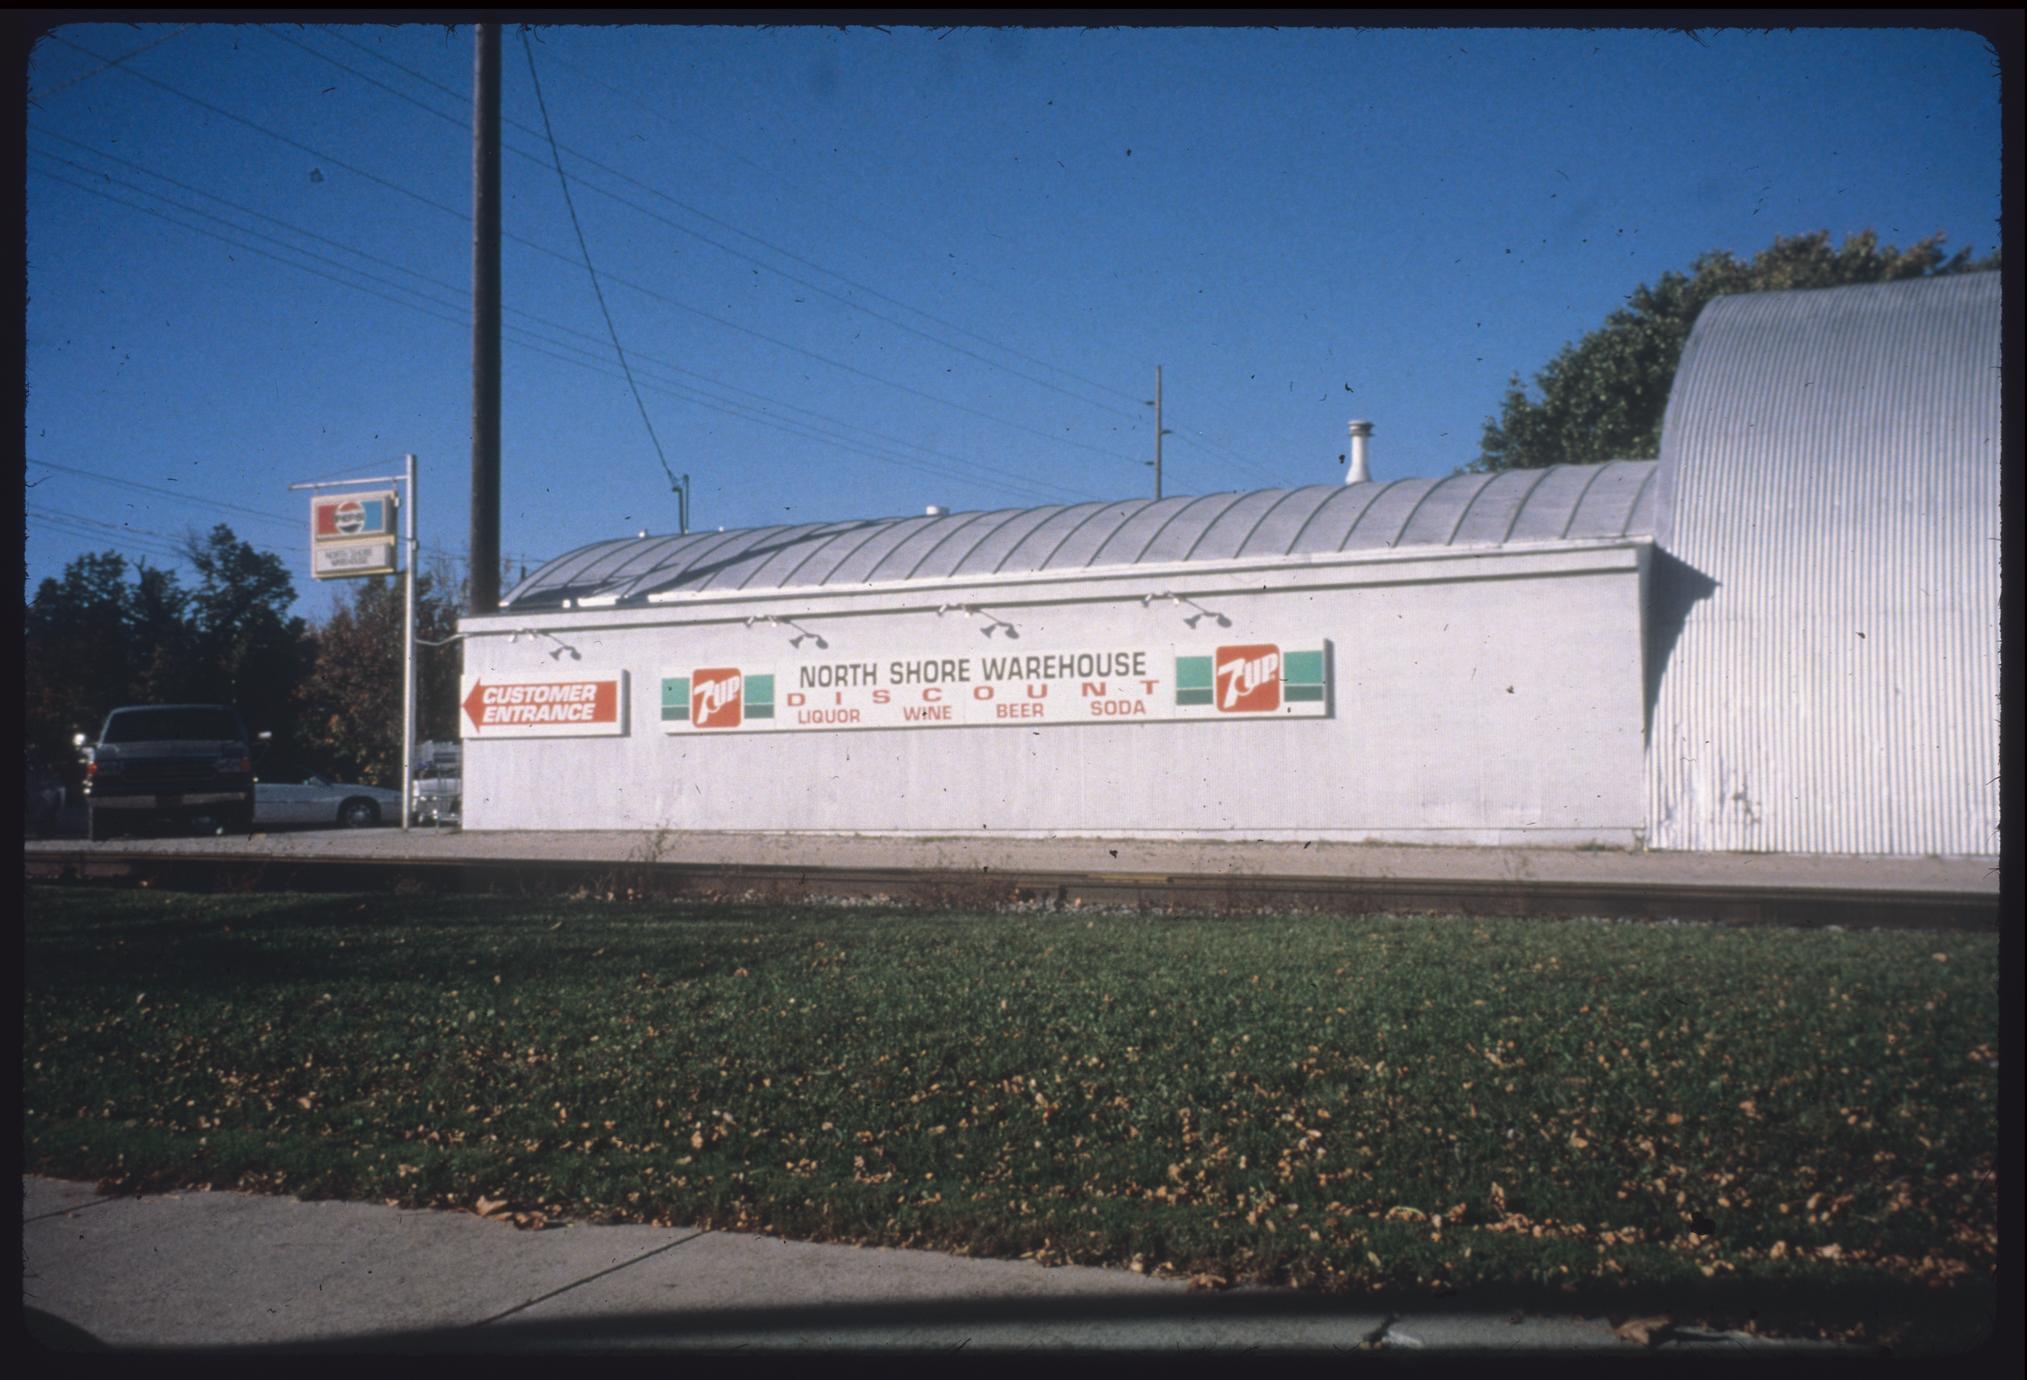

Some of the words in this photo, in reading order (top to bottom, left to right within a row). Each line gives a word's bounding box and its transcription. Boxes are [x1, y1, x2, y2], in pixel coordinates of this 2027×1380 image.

[799, 663, 878, 688] NORTH
[890, 658, 971, 684] SHORE
[982, 651, 1147, 681] WAREHOUSE
[482, 684, 597, 703] CUSTOMER
[786, 680, 1160, 707] DISCOUNT
[482, 703, 596, 723] ENTRANCE
[798, 708, 861, 724] LIQUOR
[903, 705, 952, 721] WINE
[996, 703, 1045, 718] BEER
[1090, 700, 1146, 716] SODA
